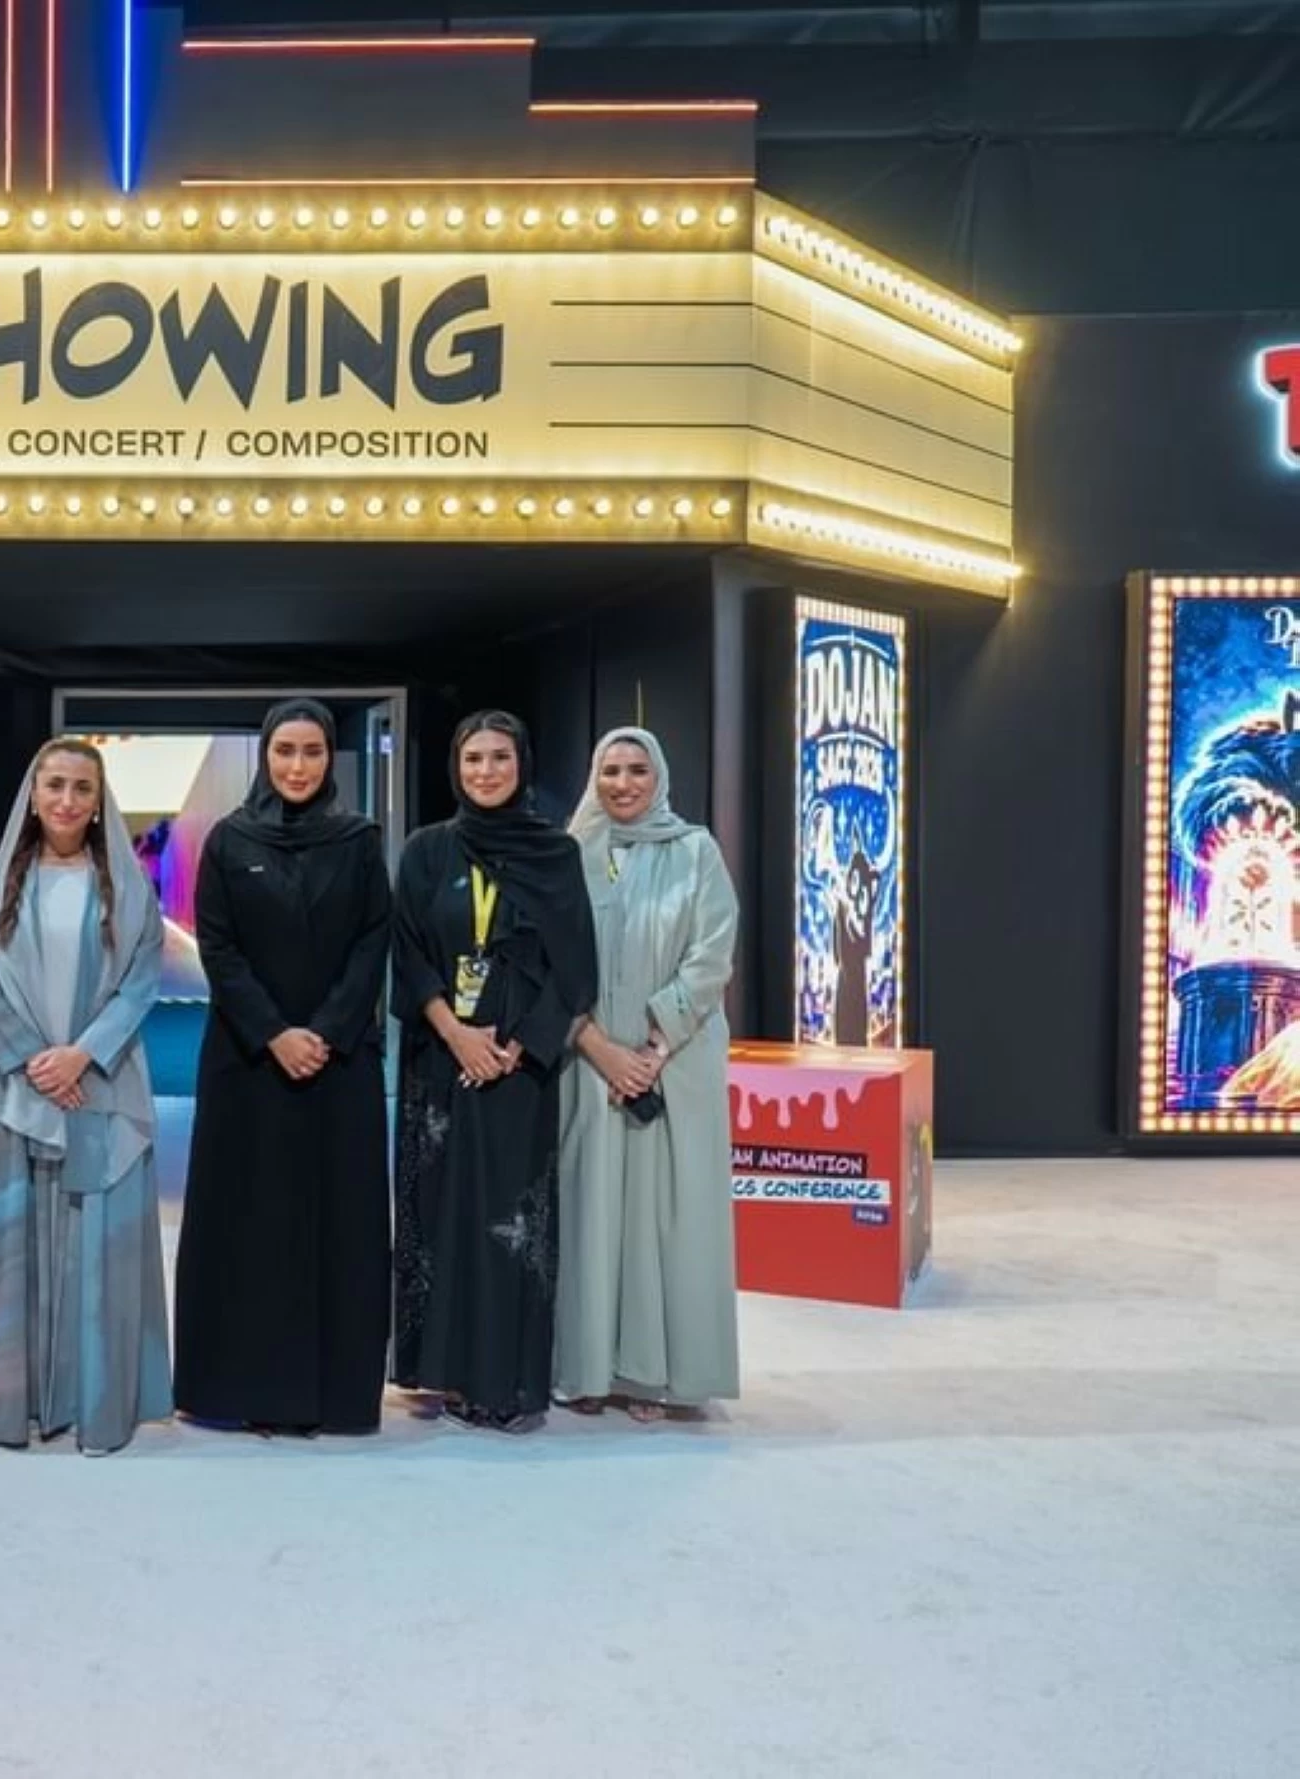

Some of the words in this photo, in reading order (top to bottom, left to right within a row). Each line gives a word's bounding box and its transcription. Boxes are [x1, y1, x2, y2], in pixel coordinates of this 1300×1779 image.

[7, 429, 186, 457] CONCERT
[226, 430, 488, 458] COMPOSITION
[805, 646, 896, 750] DOJAN
[732, 1148, 753, 1167] AH
[760, 1148, 863, 1175] ANIMATION
[763, 1180, 882, 1200] CONFERENCE
